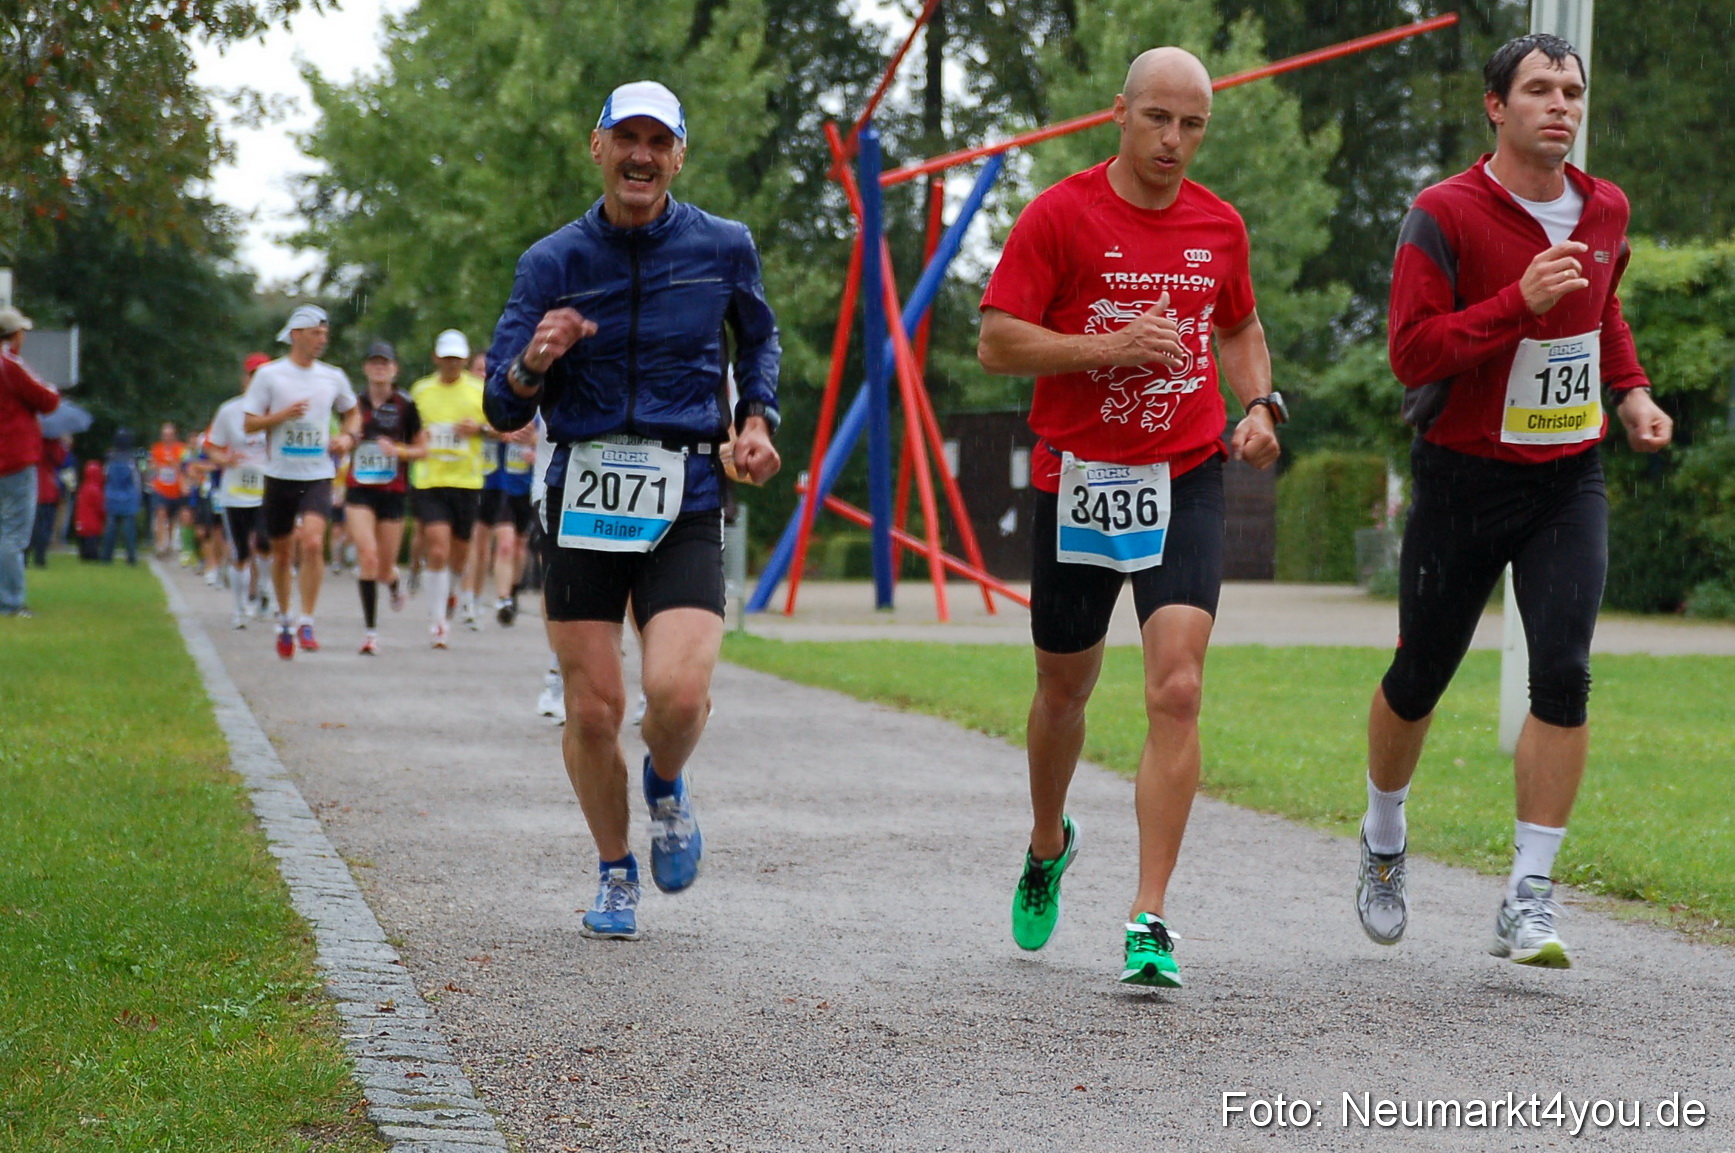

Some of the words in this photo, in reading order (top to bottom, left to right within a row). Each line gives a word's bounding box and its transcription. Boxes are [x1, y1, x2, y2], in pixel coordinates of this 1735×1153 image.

[1101, 272, 1215, 288] TRIATHLON
[1109, 284, 1207, 292] INGOLSTADT
[1548, 342, 1583, 356] BOCK
[1535, 363, 1590, 405] 134
[286, 431, 322, 446] 3412
[602, 449, 649, 463] BOCK
[576, 470, 667, 514] 2071
[1071, 485, 1158, 531] 3436
[593, 519, 644, 537] Rainer
